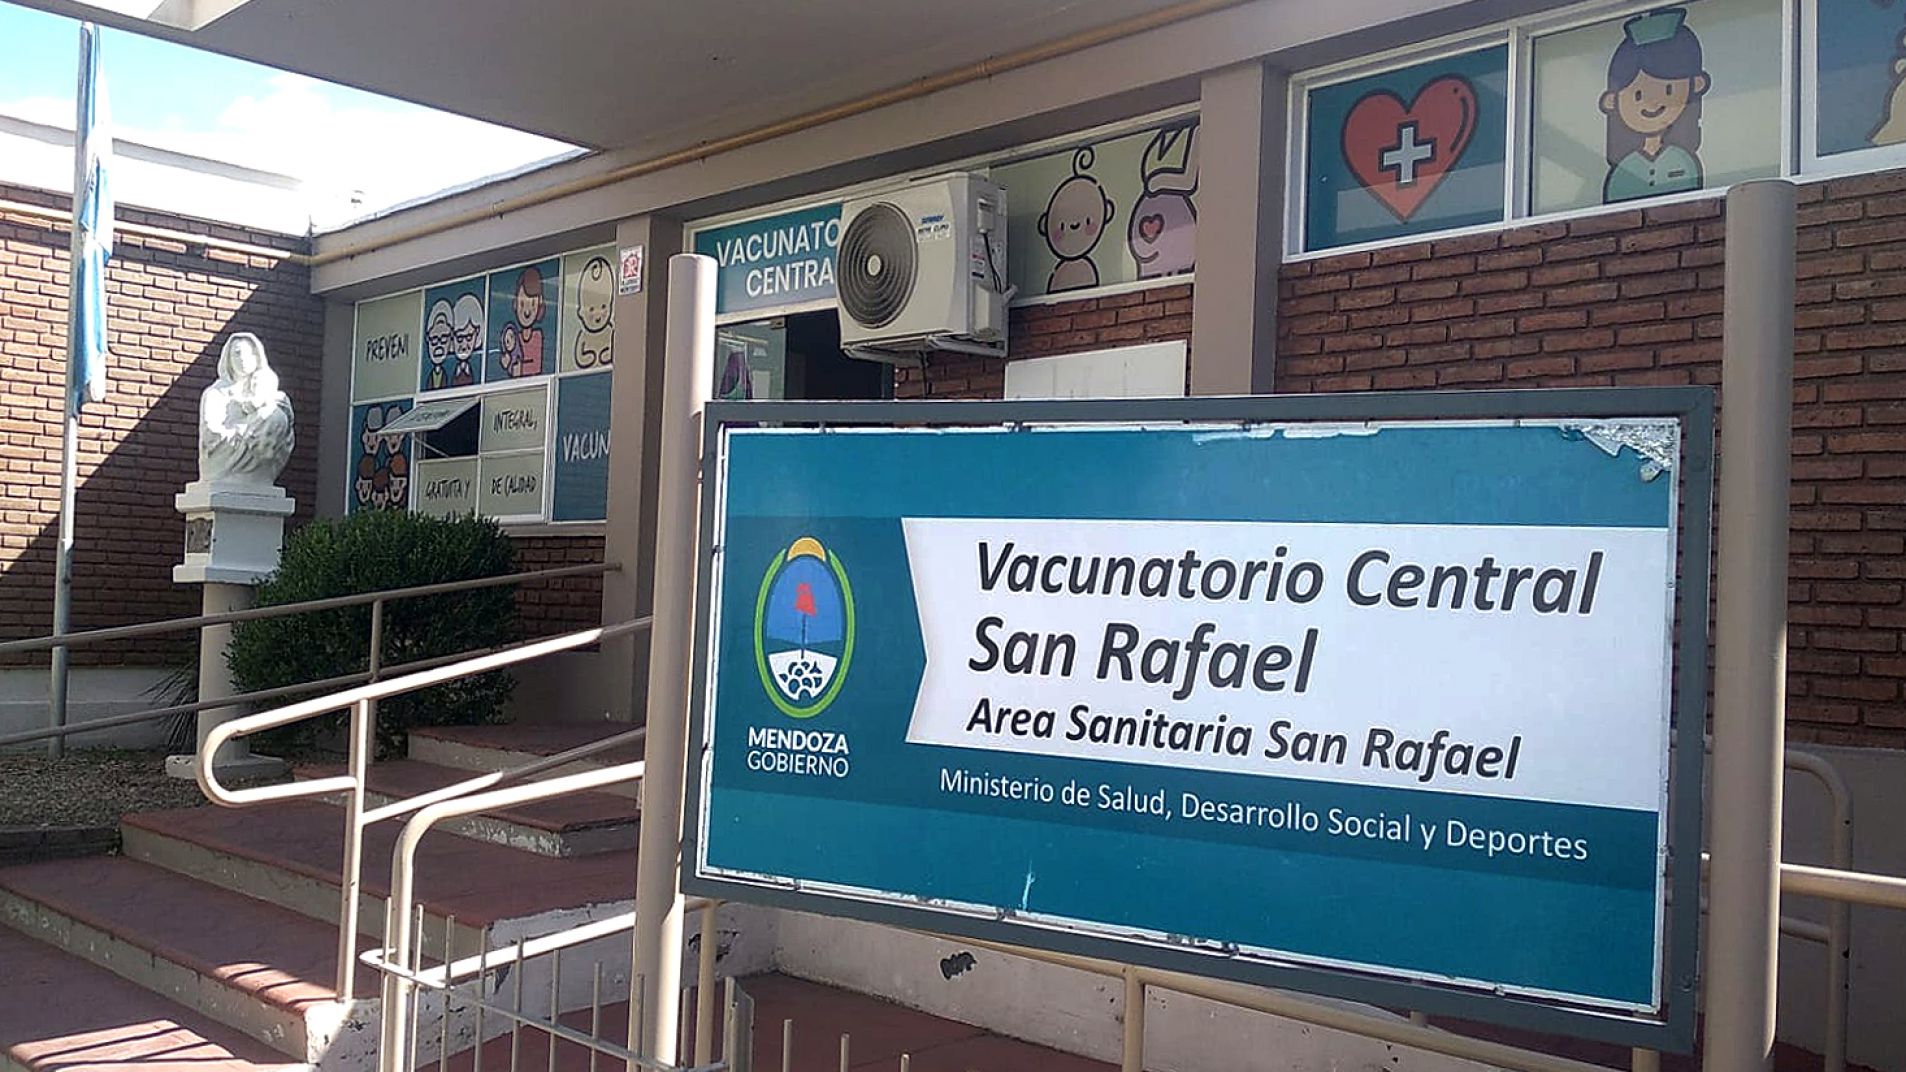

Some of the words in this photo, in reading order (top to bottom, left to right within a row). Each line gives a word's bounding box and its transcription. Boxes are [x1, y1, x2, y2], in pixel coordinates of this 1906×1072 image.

[716, 219, 840, 267] VACUNATO
[746, 257, 834, 297] CENTRA
[563, 430, 610, 462] VACUN
[491, 477, 502, 495] DE
[504, 474, 537, 497] CALIDAD
[978, 542, 1324, 604] Vacunatorio
[1346, 549, 1604, 615] Central
[968, 616, 1076, 677] San
[1096, 622, 1319, 701] Rafael
[748, 726, 849, 755] MENDOZA
[965, 697, 1056, 739] Area
[1065, 704, 1253, 756] Sanitaria
[1264, 720, 1348, 765] San
[1362, 728, 1522, 783] Rafael
[747, 750, 849, 778] GOBIERNO
[940, 768, 1054, 802] Ministerio
[1061, 779, 1090, 806] de
[1098, 784, 1172, 820] Salud,
[1182, 793, 1319, 831] Desarrollo
[1328, 808, 1410, 842] Social
[1420, 824, 1436, 850] y
[1447, 820, 1587, 860] Deportes
